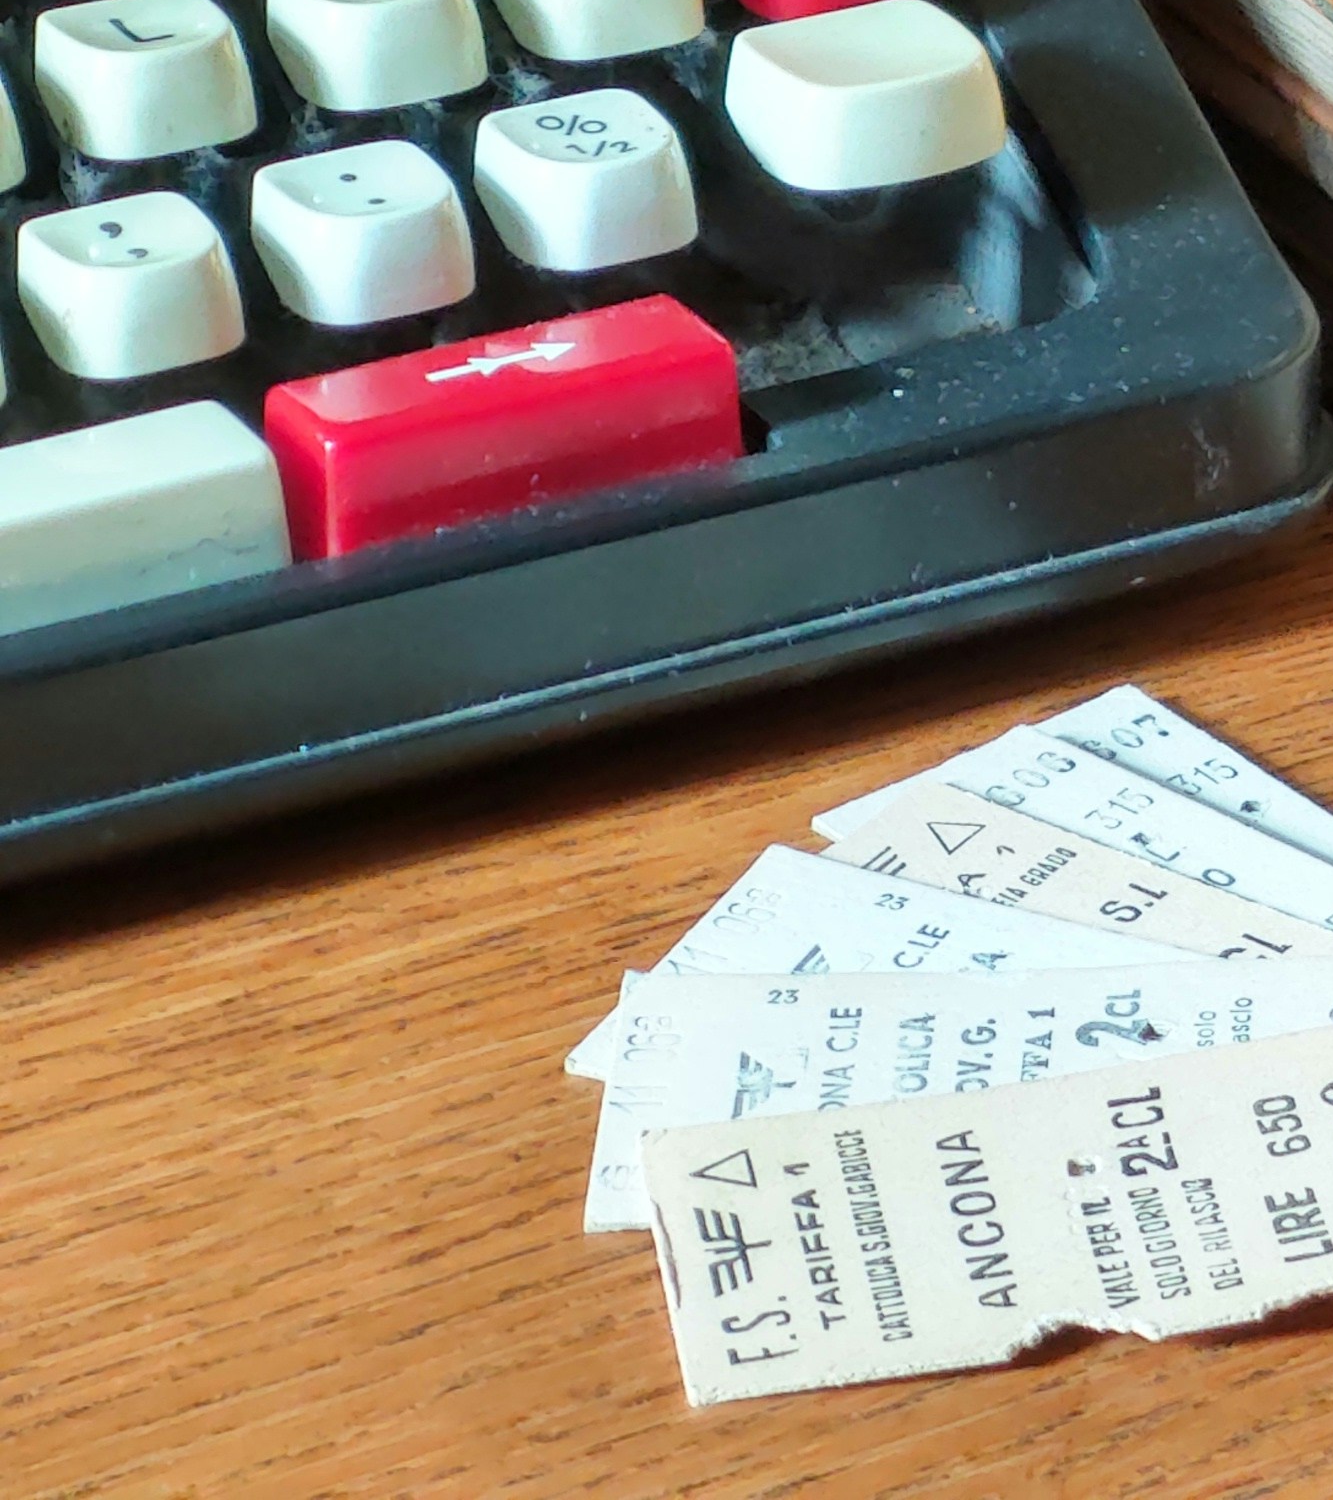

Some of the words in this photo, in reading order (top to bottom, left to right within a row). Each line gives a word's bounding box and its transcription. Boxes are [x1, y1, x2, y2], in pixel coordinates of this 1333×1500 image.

[108, 17, 175, 44] L
[564, 139, 641, 157] 1/2
[984, 750, 1077, 807] 606
[1166, 758, 1240, 797] 315
[1084, 786, 1155, 830] 315
[1019, 845, 1079, 888] GRADO
[873, 892, 911, 912] 23
[767, 988, 800, 1005] 23
[1027, 1005, 1056, 1019] 1
[1196, 1009, 1217, 1048] solo
[1252, 1093, 1312, 1158] 650
[783, 1161, 811, 1176] 1
[935, 1129, 1018, 1308] ANCONA
[1086, 1220, 1125, 1258] PER
[791, 1188, 847, 1331] TARIFFA
[1208, 1256, 1244, 1291] DEL
[864, 1252, 914, 1343] CATTOLICA
[1097, 1260, 1141, 1309] VALE
